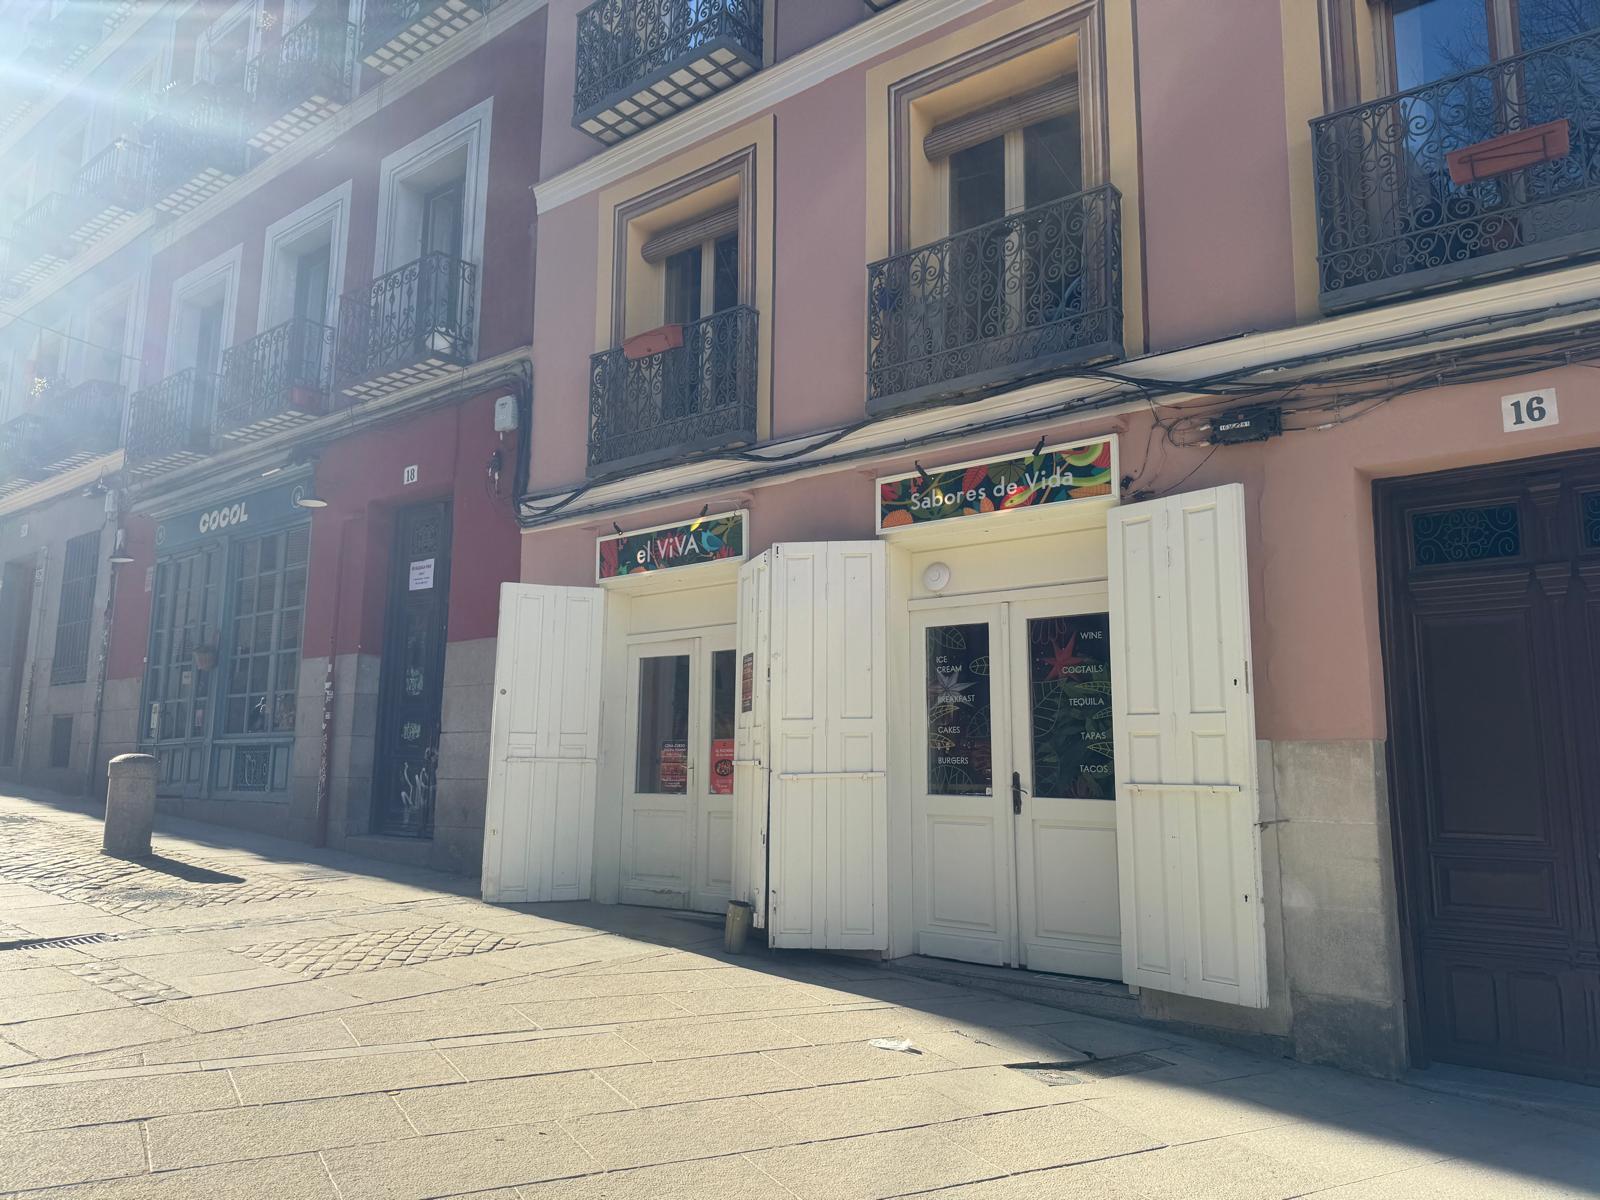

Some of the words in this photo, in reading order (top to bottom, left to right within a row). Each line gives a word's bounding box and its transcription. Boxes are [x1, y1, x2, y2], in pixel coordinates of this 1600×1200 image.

[1510, 396, 1546, 425] 16
[406, 467, 416, 482] 18
[911, 485, 986, 511] Sabores
[993, 476, 1018, 497] de
[1024, 466, 1073, 492] Vida
[199, 502, 249, 533] COCOL
[636, 540, 651, 564] el
[657, 533, 700, 560] ViVA
[1080, 631, 1103, 640] WINE
[935, 655, 948, 664] ICE
[936, 664, 963, 673] CREAM
[1062, 664, 1104, 674] COCTAILS
[937, 694, 976, 703] BREAKFAST
[1068, 697, 1105, 706] TEQUILA
[937, 726, 961, 734] CAKES
[1080, 731, 1107, 740] TAPAS
[937, 756, 969, 765] BURGERS
[1079, 764, 1109, 773] TACOS
